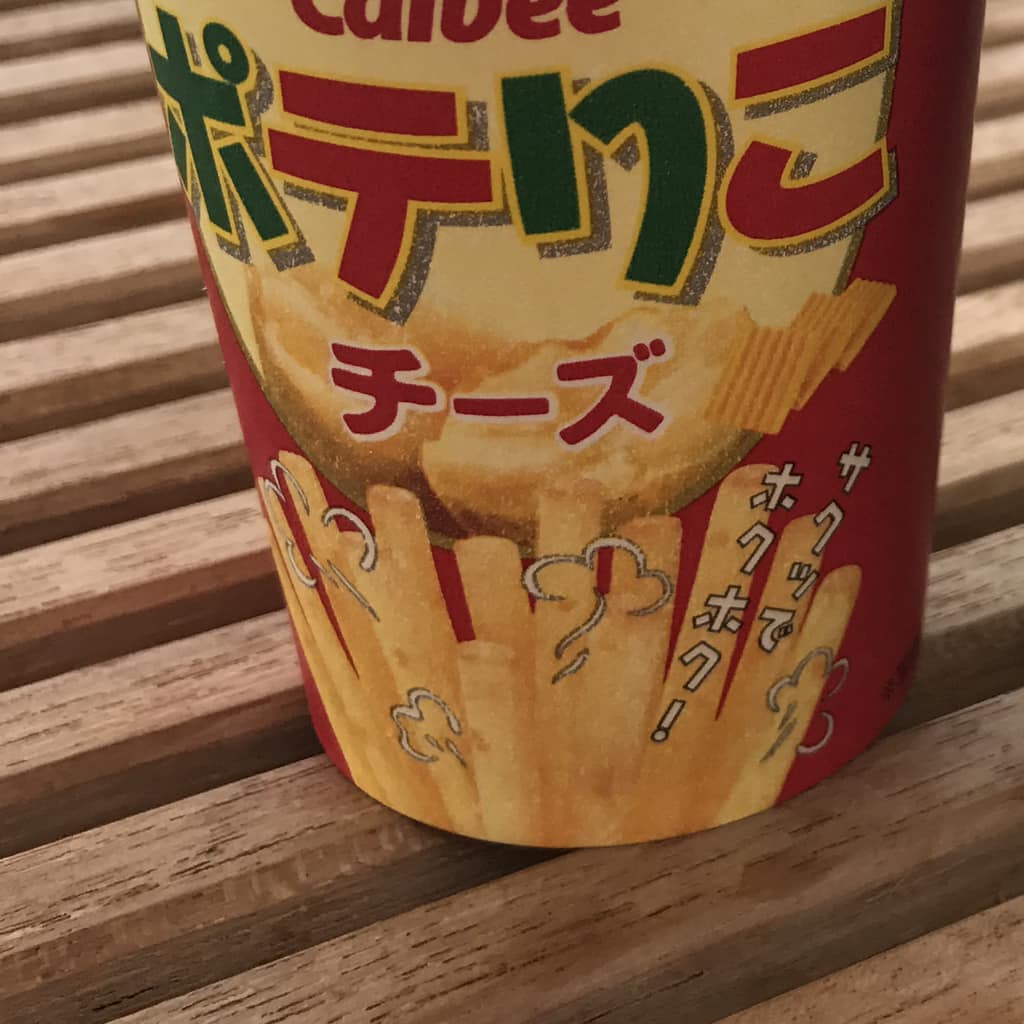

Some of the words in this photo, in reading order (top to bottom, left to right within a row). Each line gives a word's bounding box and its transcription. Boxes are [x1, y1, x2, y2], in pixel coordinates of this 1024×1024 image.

[149, 2, 894, 310] ポテりこ
[330, 337, 667, 446] チーズ
